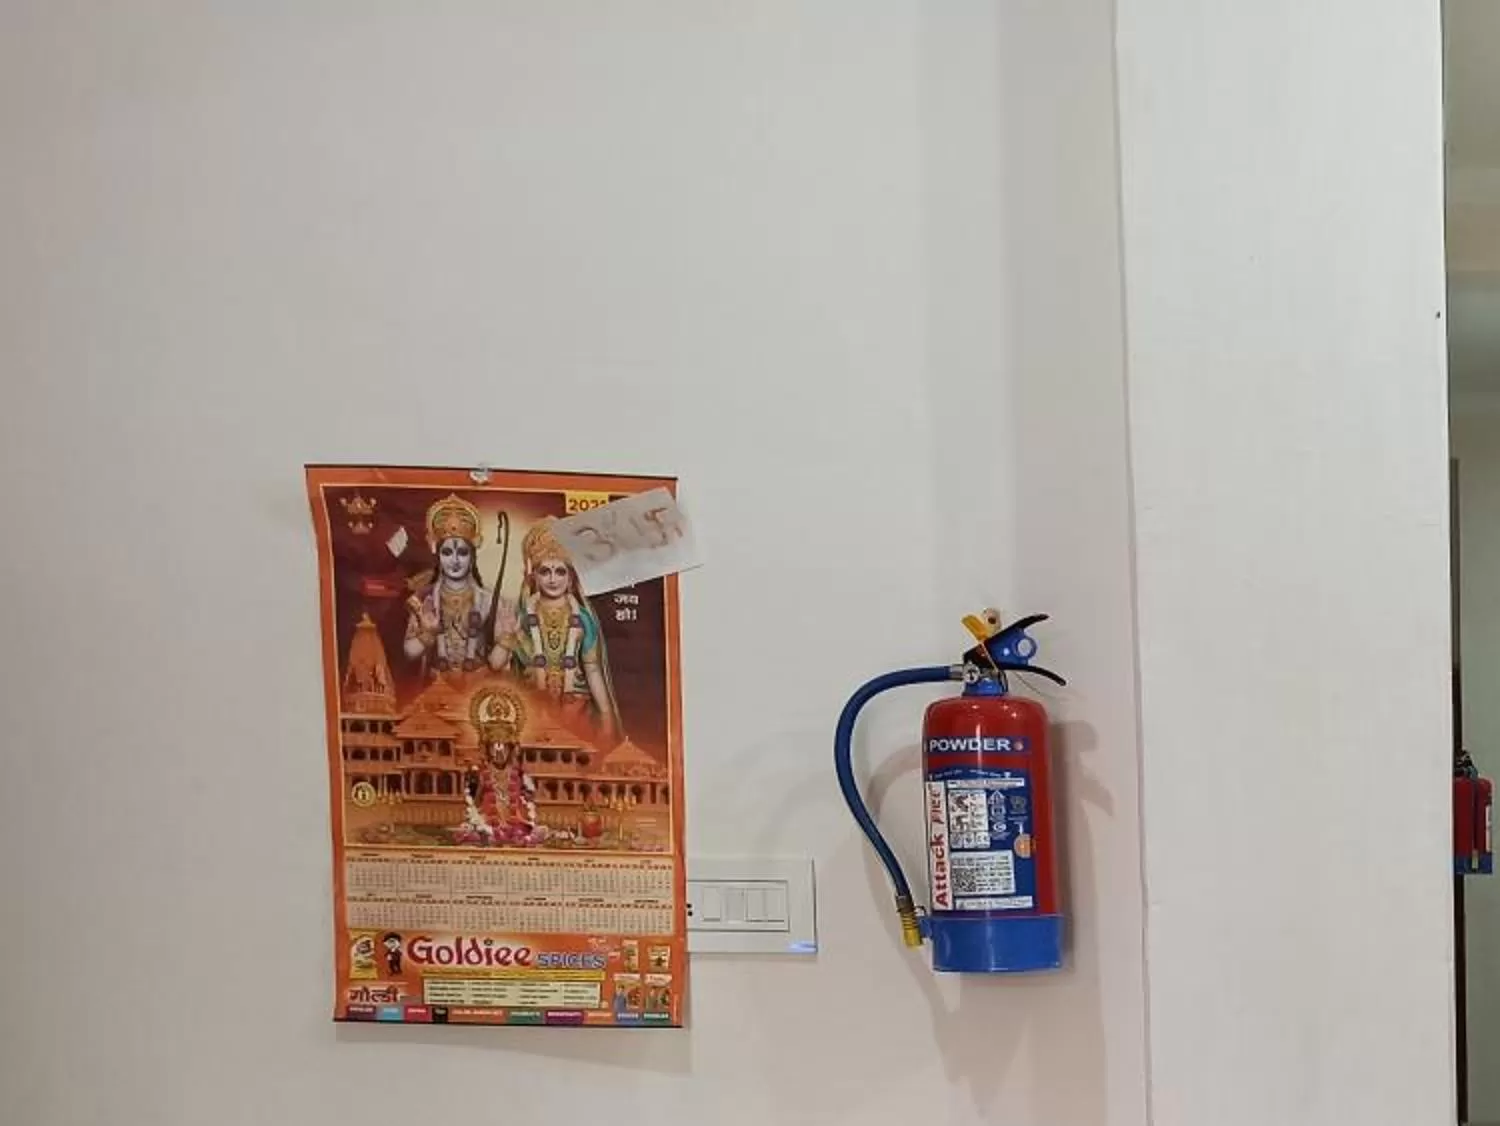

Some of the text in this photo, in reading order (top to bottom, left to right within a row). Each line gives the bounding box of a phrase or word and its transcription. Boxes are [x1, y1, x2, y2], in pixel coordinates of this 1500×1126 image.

[929, 737, 1012, 752] POWDER
[930, 833, 948, 908] Attack
[407, 935, 532, 967] Goldiee
